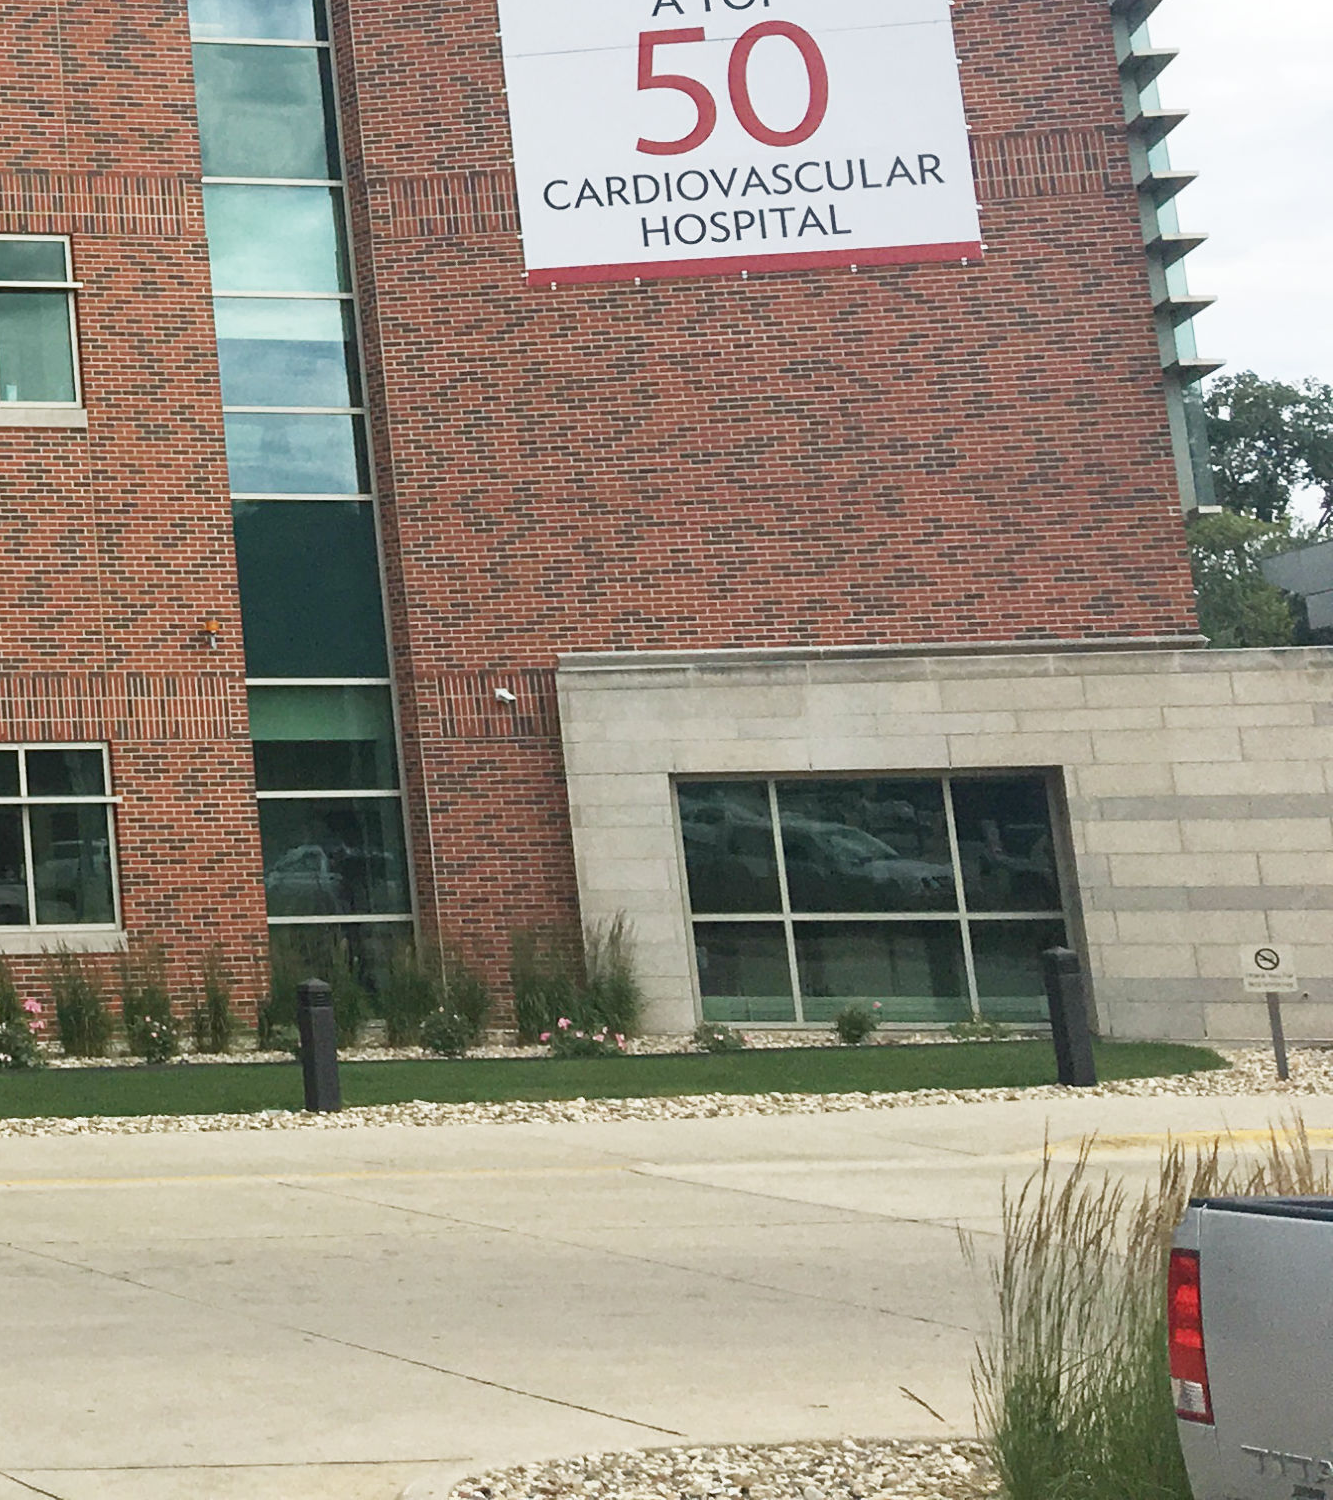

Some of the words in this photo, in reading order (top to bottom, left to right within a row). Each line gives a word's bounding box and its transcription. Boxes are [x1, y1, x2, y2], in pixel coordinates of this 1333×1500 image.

[635, 19, 829, 156] 50
[543, 152, 946, 211] CARDIOVASCULAR
[640, 203, 853, 248] HOSPITAL
